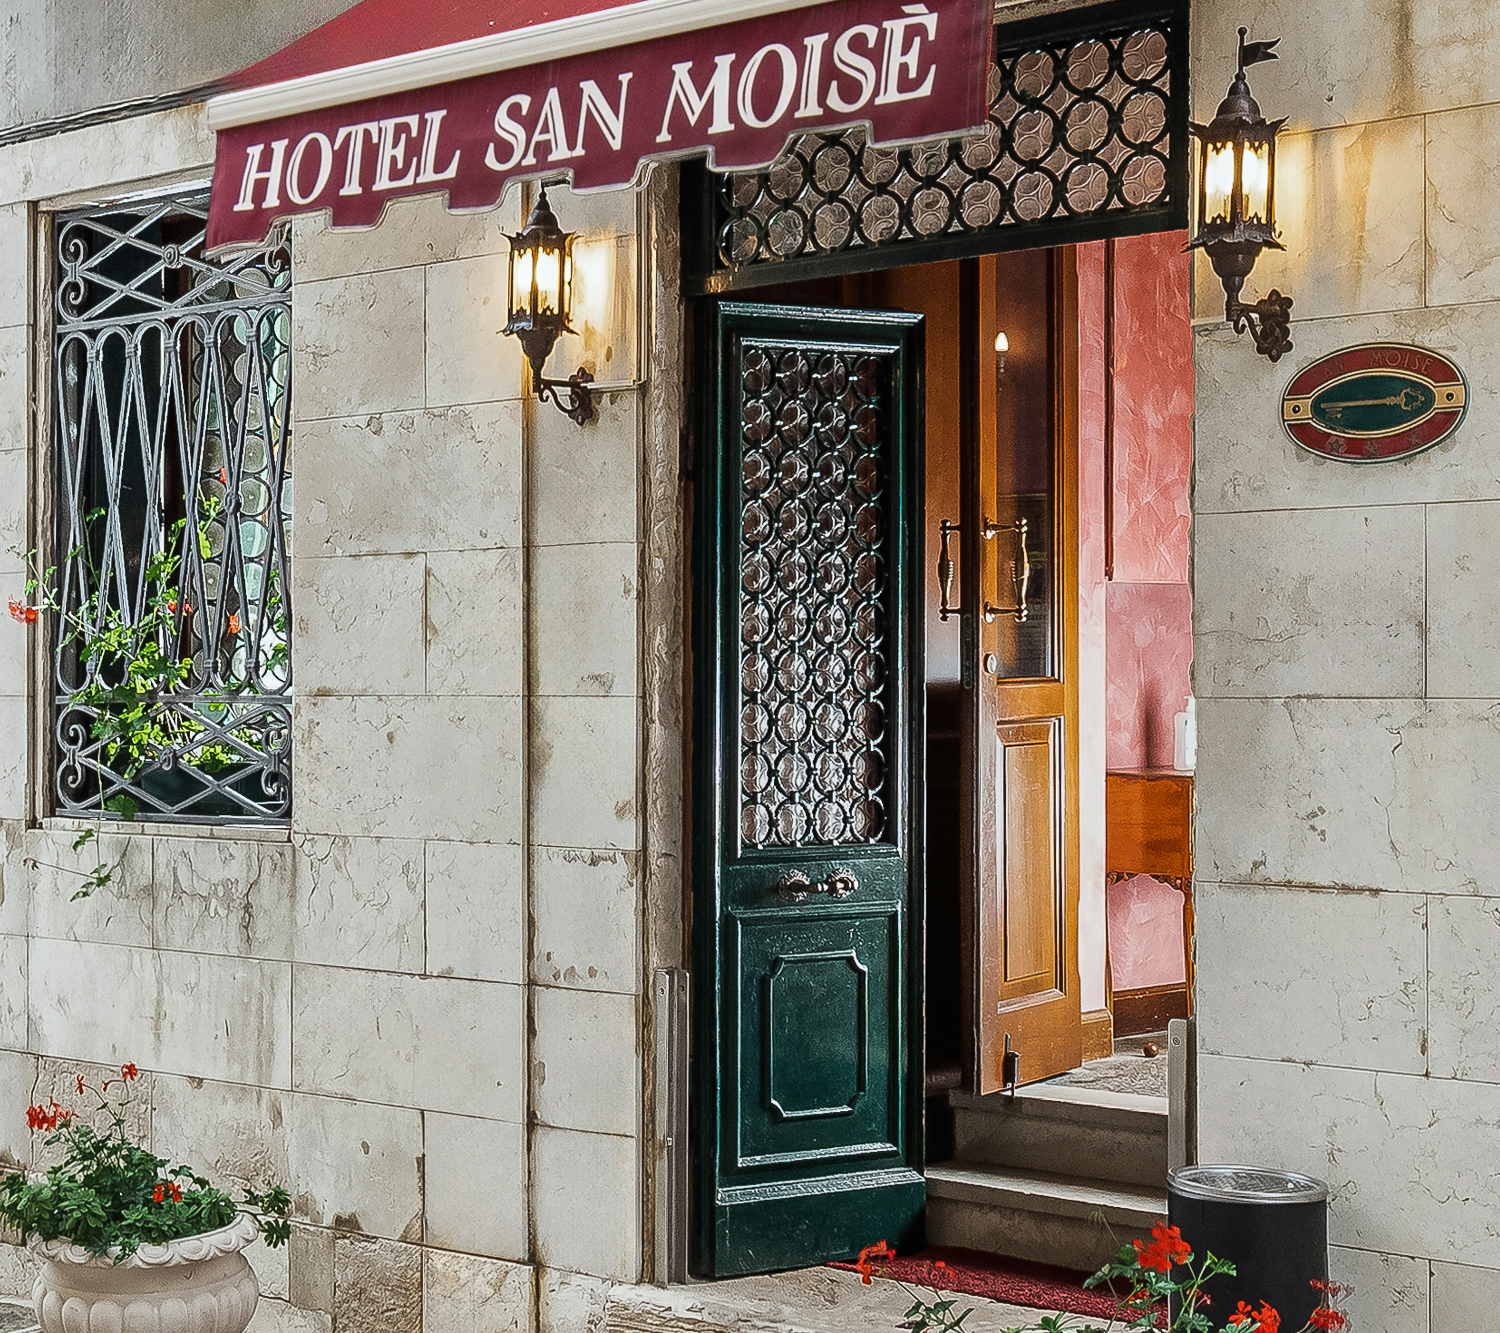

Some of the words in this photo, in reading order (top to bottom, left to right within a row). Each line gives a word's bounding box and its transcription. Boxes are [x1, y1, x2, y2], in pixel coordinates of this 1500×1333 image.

[232, 109, 461, 212] HOTEL
[483, 72, 634, 172] SAN
[654, 3, 938, 143] MOISÈ
